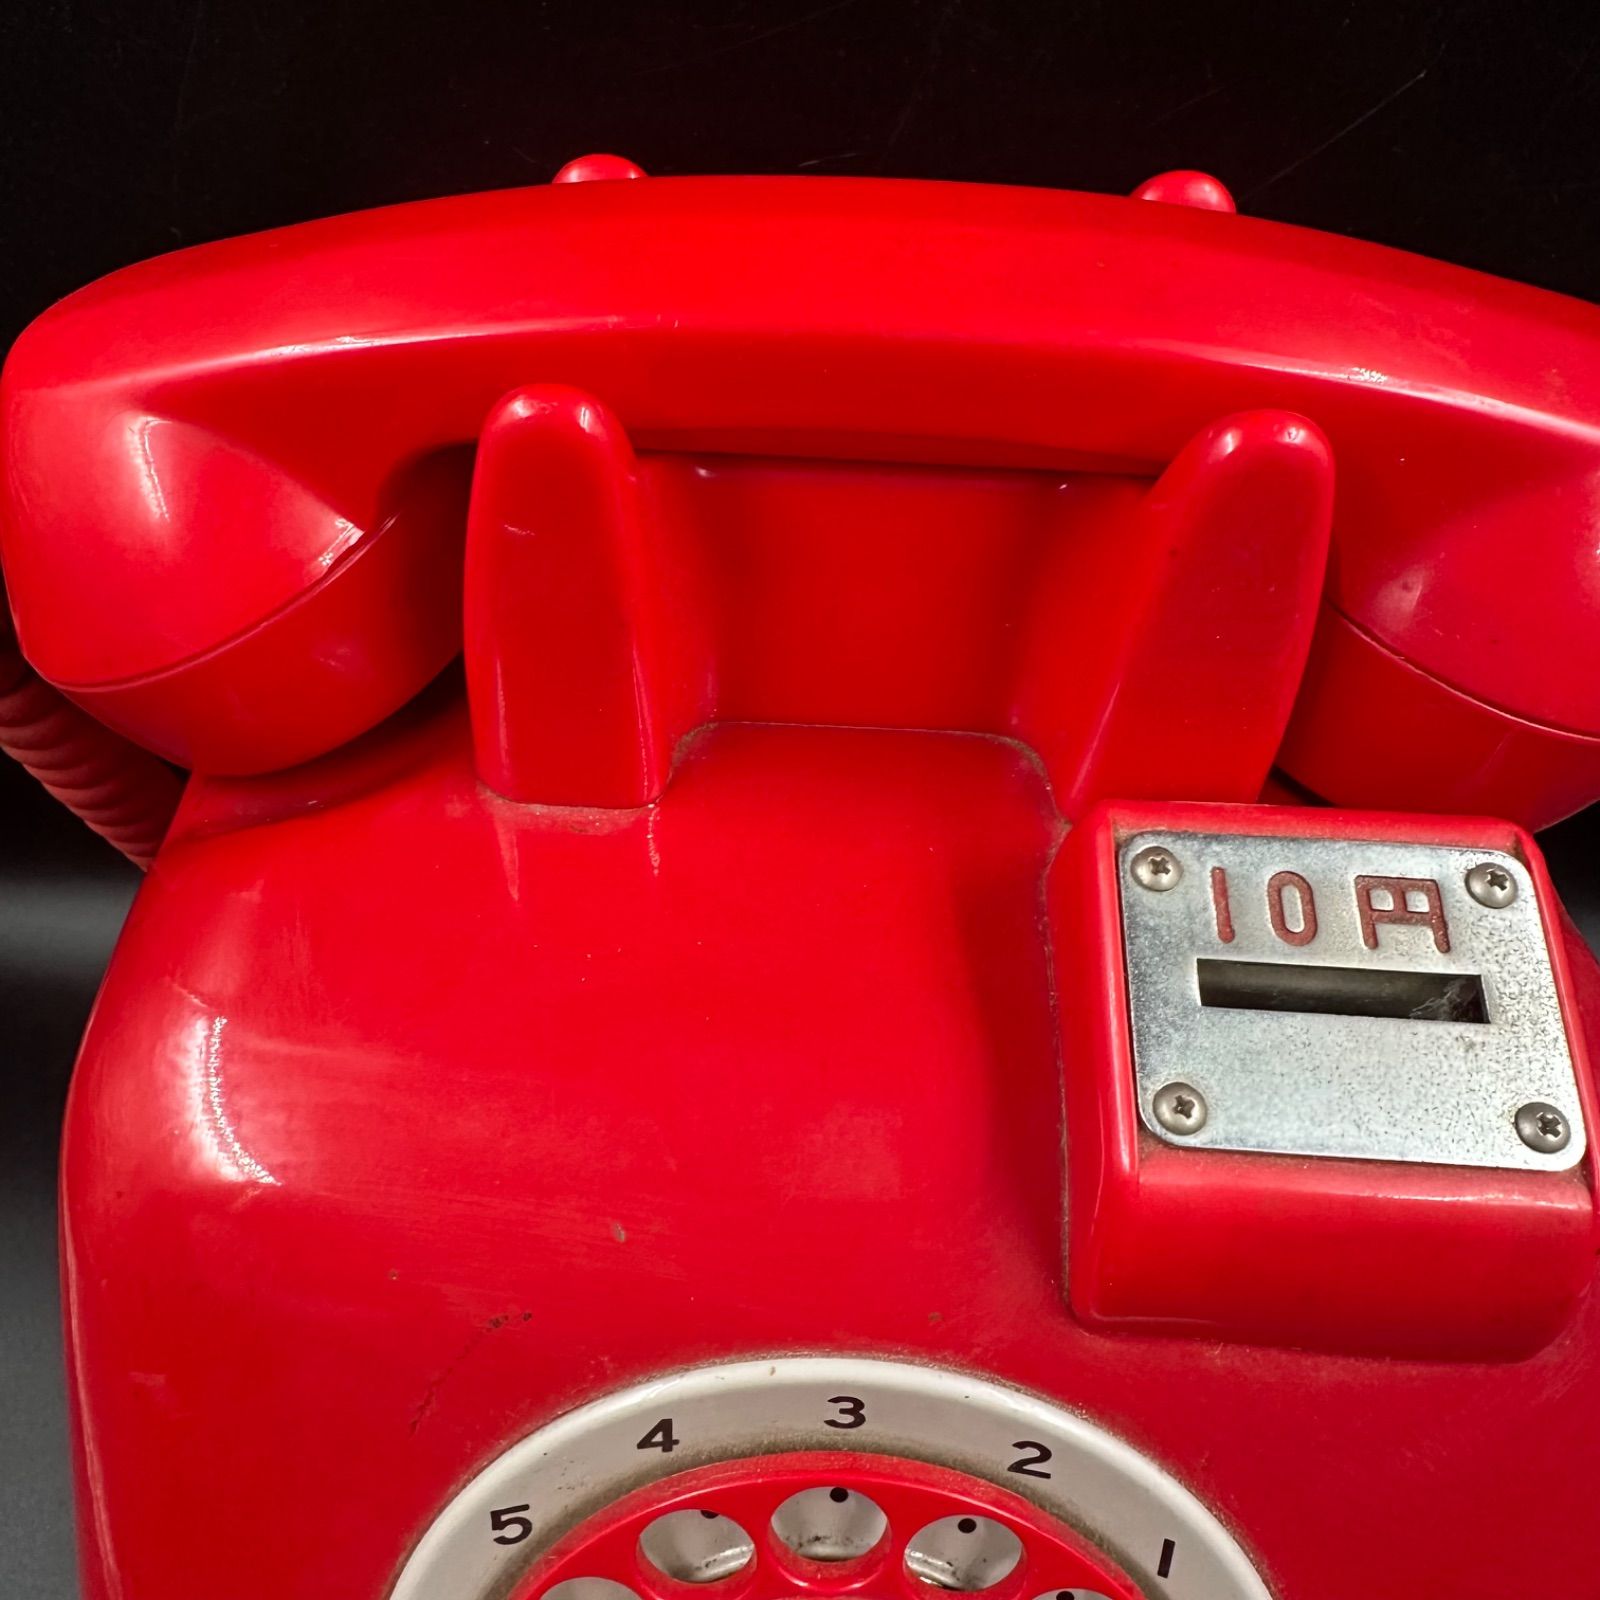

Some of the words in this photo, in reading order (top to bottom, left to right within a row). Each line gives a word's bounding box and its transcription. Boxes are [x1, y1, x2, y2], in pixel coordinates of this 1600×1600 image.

[824, 1395, 866, 1429] 3
[637, 1418, 680, 1452] 4
[1007, 1440, 1052, 1479] 2
[490, 1503, 533, 1545] 5
[1157, 1538, 1176, 1579] 1
